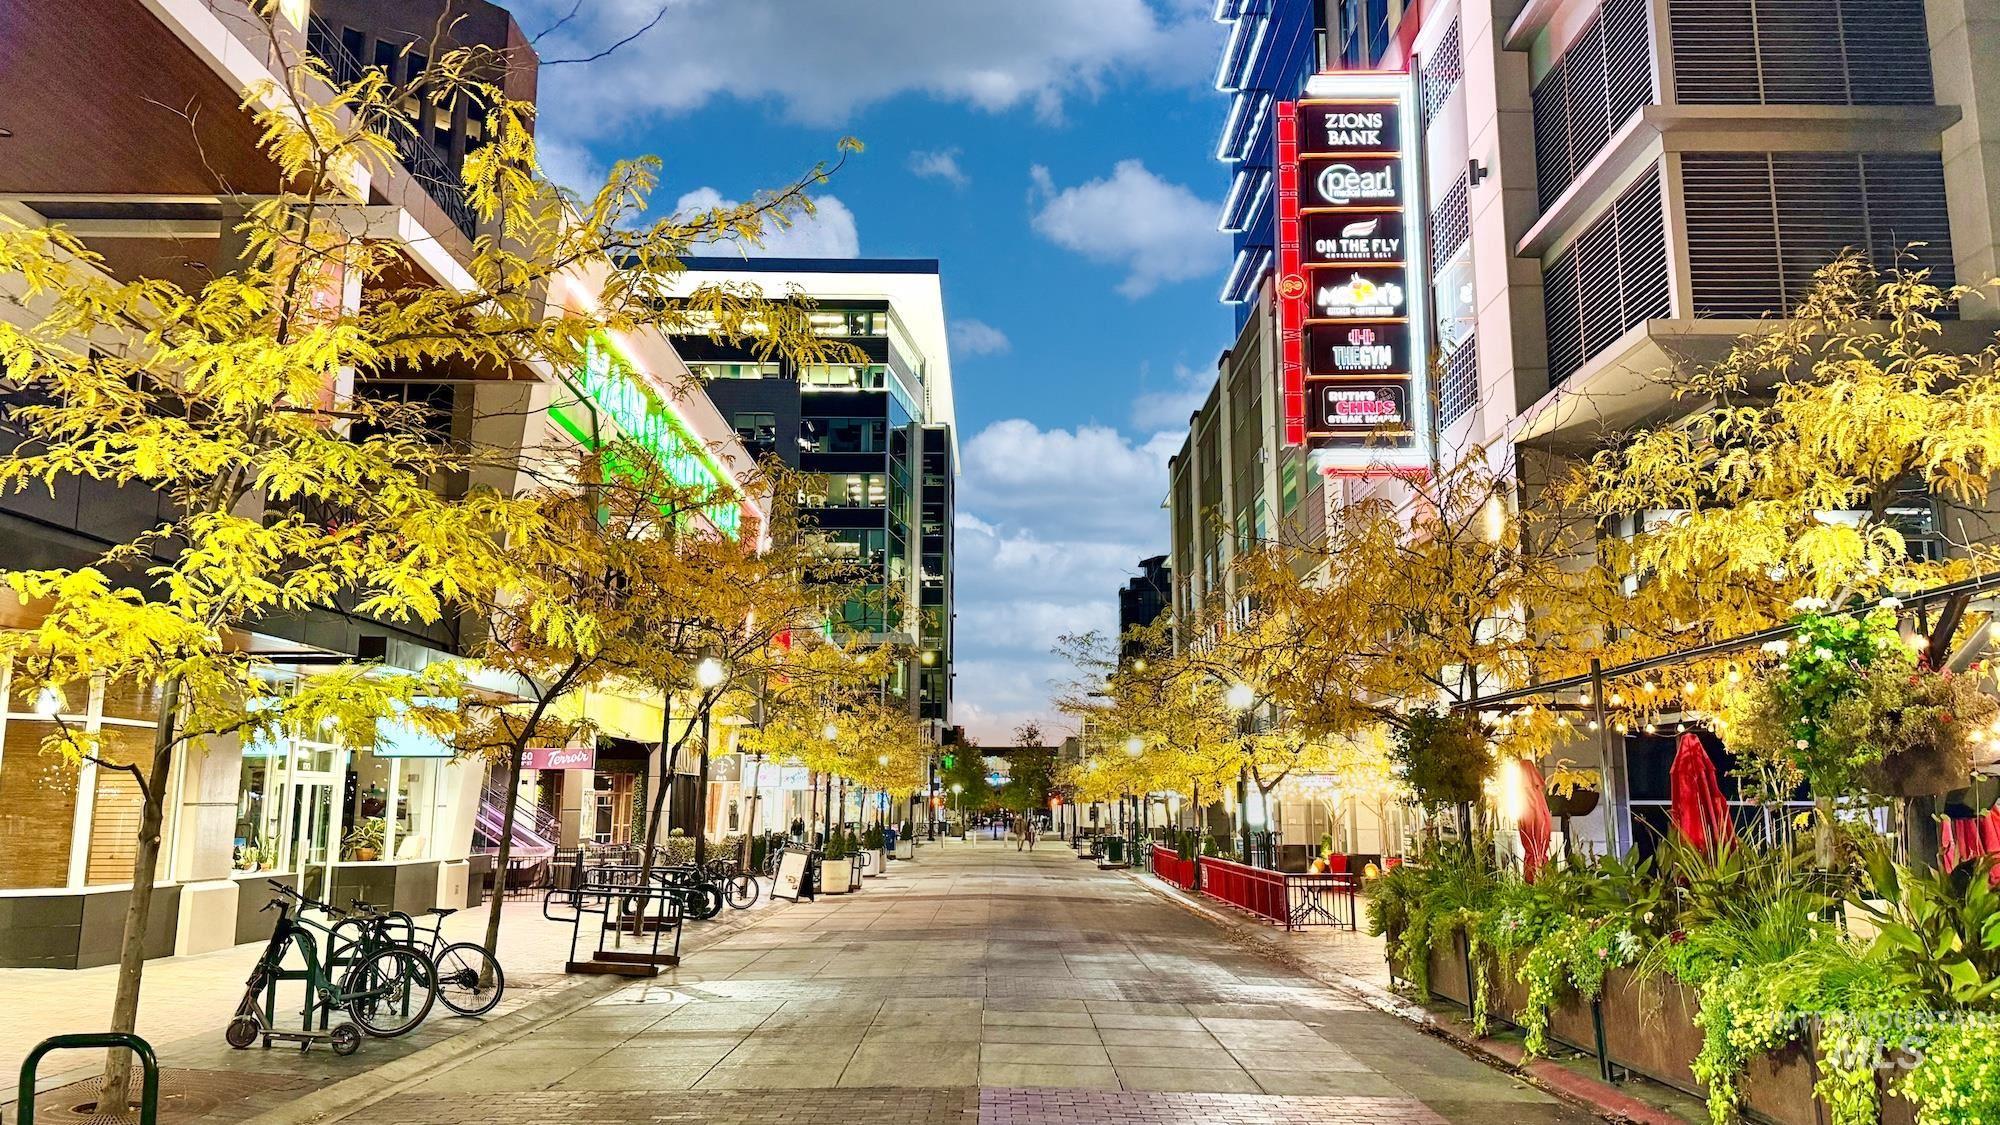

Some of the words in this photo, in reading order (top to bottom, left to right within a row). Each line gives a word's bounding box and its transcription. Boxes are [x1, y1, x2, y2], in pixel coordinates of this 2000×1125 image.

[1324, 113, 1383, 129] ZIONS
[1328, 130, 1381, 146] BANK
[1326, 165, 1392, 197] pearl
[1315, 239, 1337, 253] ON
[1339, 239, 1369, 253] THE
[1372, 238, 1400, 253] FLY
[1335, 400, 1396, 415] CHRIS
[1327, 414, 1363, 424] STEAK
[547, 750, 589, 768] Terroir
